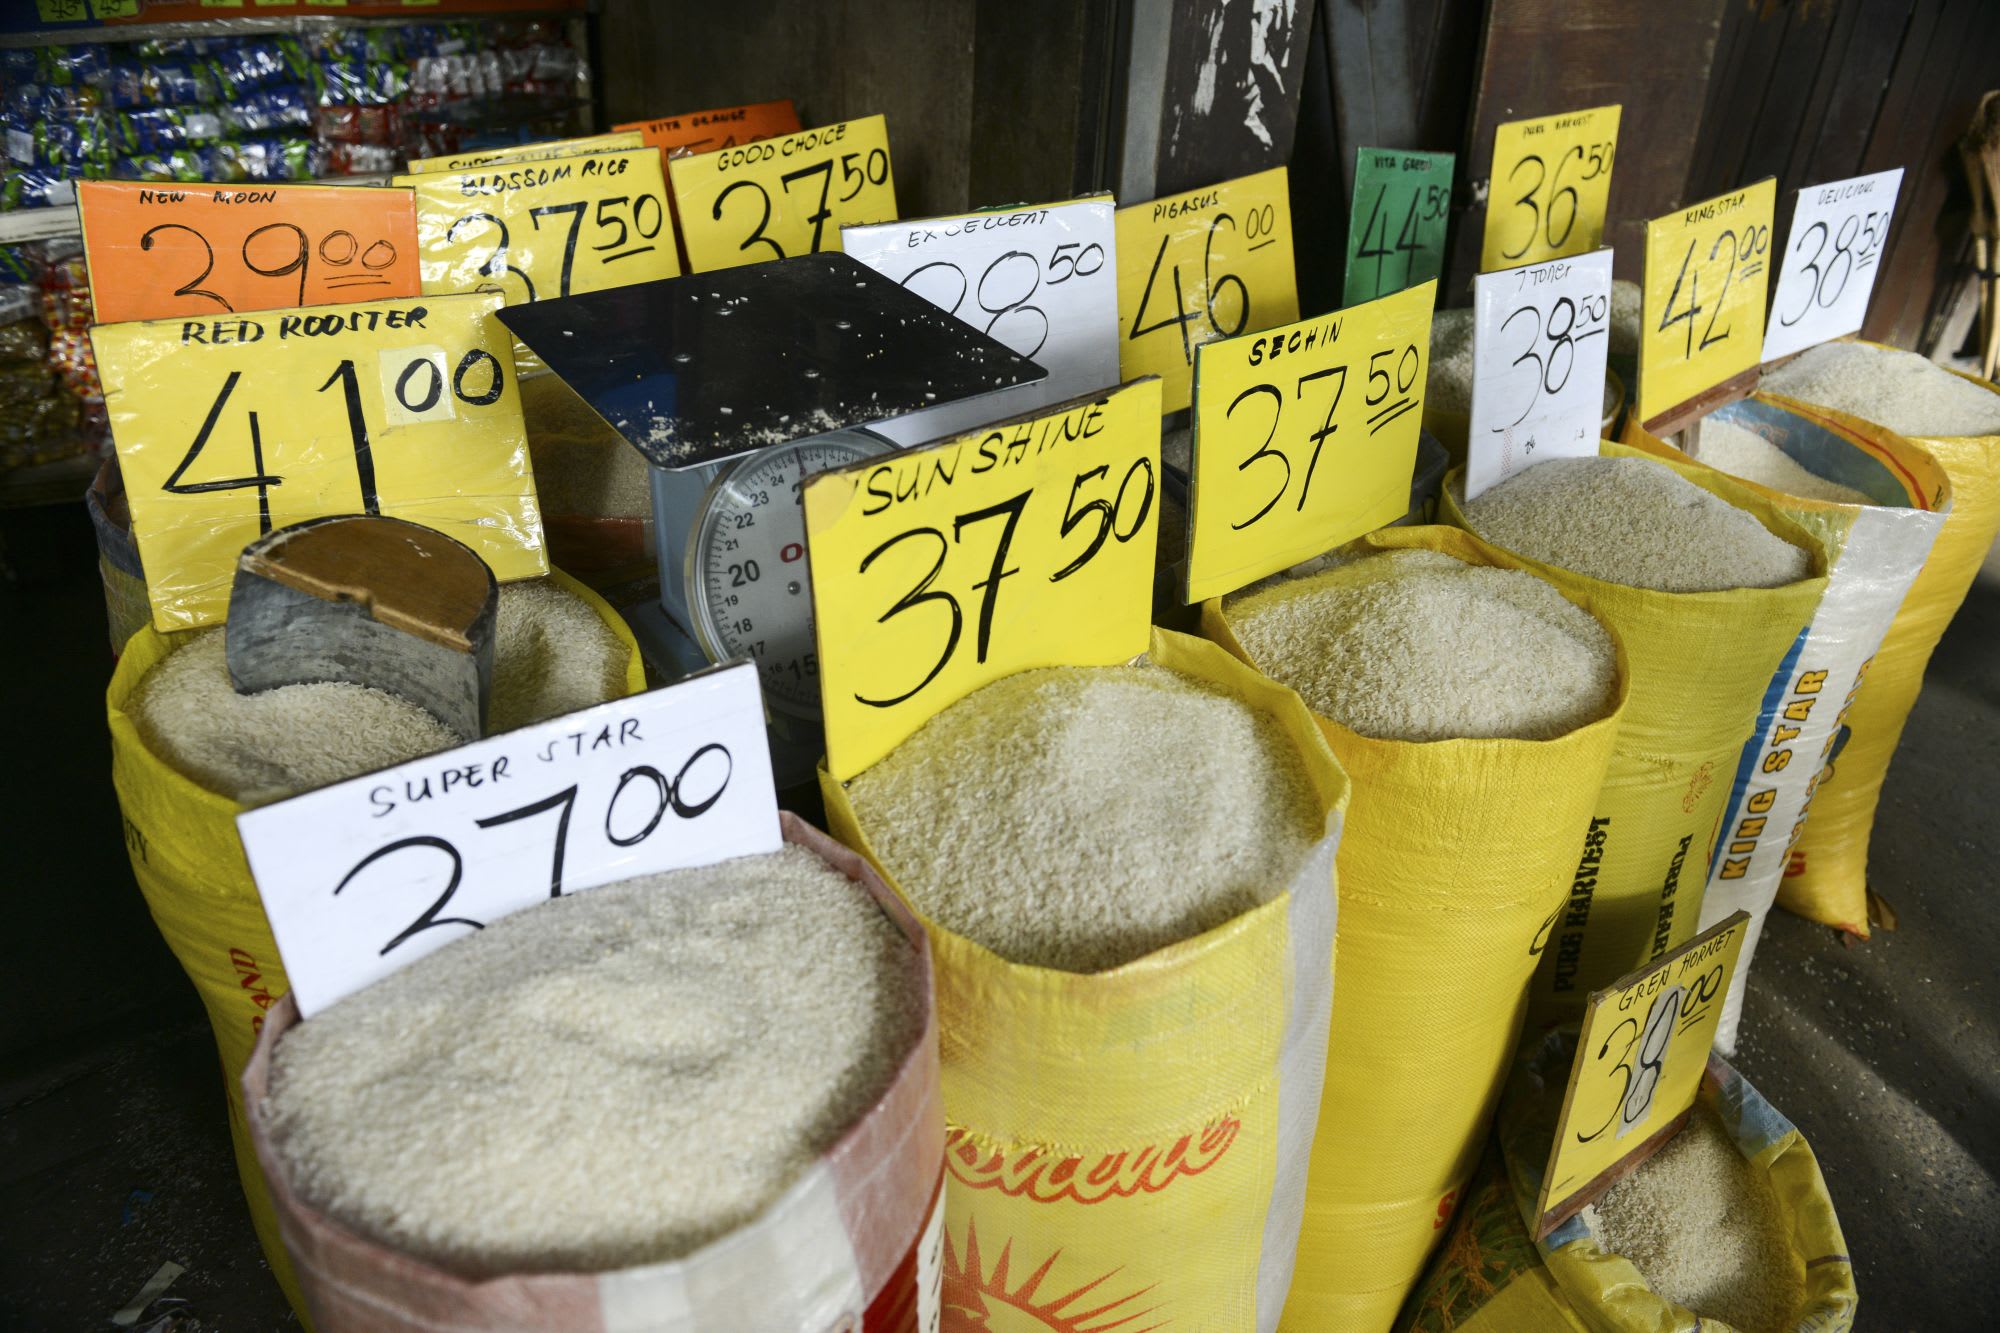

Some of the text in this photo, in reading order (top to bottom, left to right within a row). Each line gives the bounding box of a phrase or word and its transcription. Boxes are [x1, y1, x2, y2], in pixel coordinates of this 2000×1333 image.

[718, 143, 776, 171] GOOD
[781, 124, 847, 157] CHOICE
[1375, 156, 1396, 168] VITA
[461, 159, 629, 197] BLOSSOM RICE
[140, 190, 276, 204] NEW MOON
[1153, 190, 1218, 222] PIGASUS
[908, 211, 1049, 247] EXCELLENT
[182, 306, 428, 347] RED ROOSTER
[1249, 317, 1343, 366] SECHIN
[770, 474, 784, 487] 24
[750, 491, 770, 508] 23
[734, 512, 755, 529] 22
[725, 539, 739, 551] 21
[728, 559, 760, 587] 20
[724, 595, 739, 607] 19
[734, 618, 753, 634] 18
[748, 640, 765, 657] 17
[769, 663, 783, 674] 16
[789, 654, 817, 680] 15
[369, 718, 643, 817] SUPER STAR
[1720, 787, 1777, 881] KING
[1763, 669, 1828, 774] STAR
[1662, 833, 1694, 899] PURE
[1553, 816, 1611, 992] PURE HARVEST
[1619, 929, 1735, 1012] GREN HORNET
